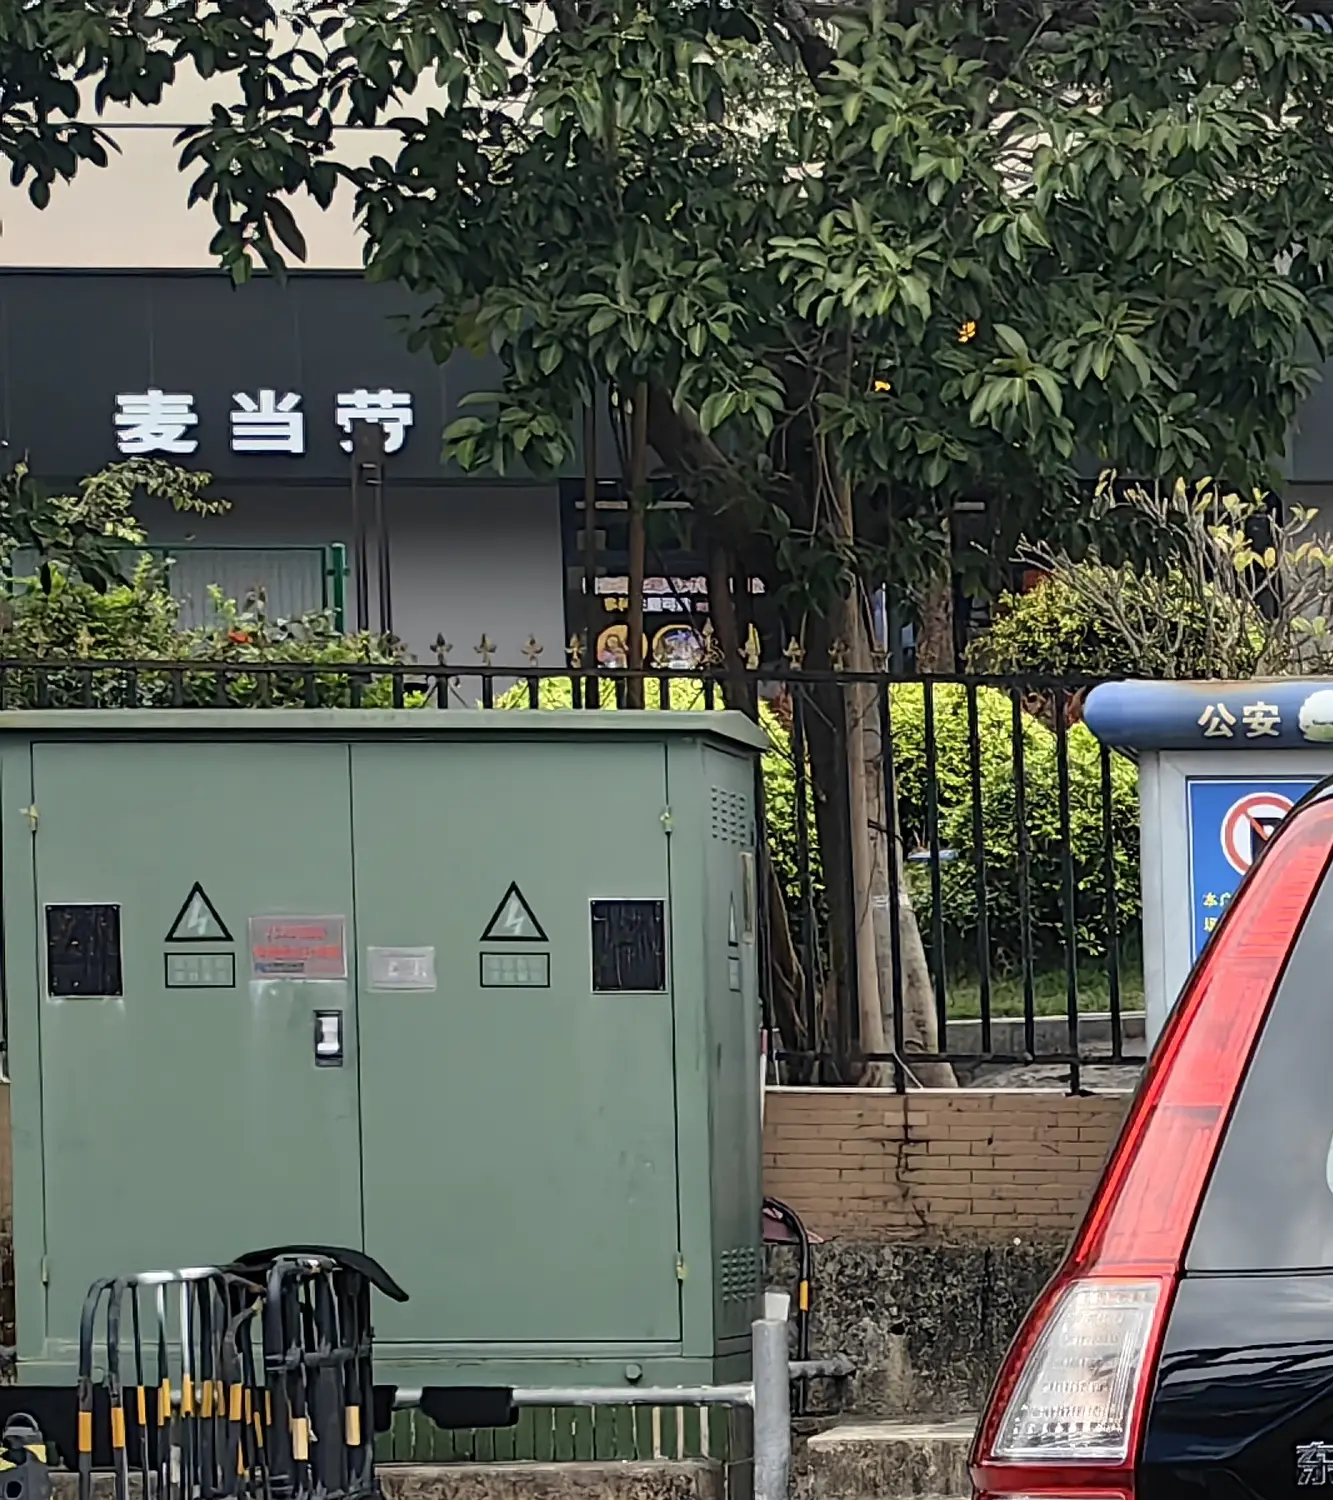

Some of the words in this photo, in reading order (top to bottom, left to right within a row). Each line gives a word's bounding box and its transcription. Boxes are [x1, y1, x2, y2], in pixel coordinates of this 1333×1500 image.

[114, 388, 413, 453] 麦当劳
[1198, 701, 1282, 738] 公安
